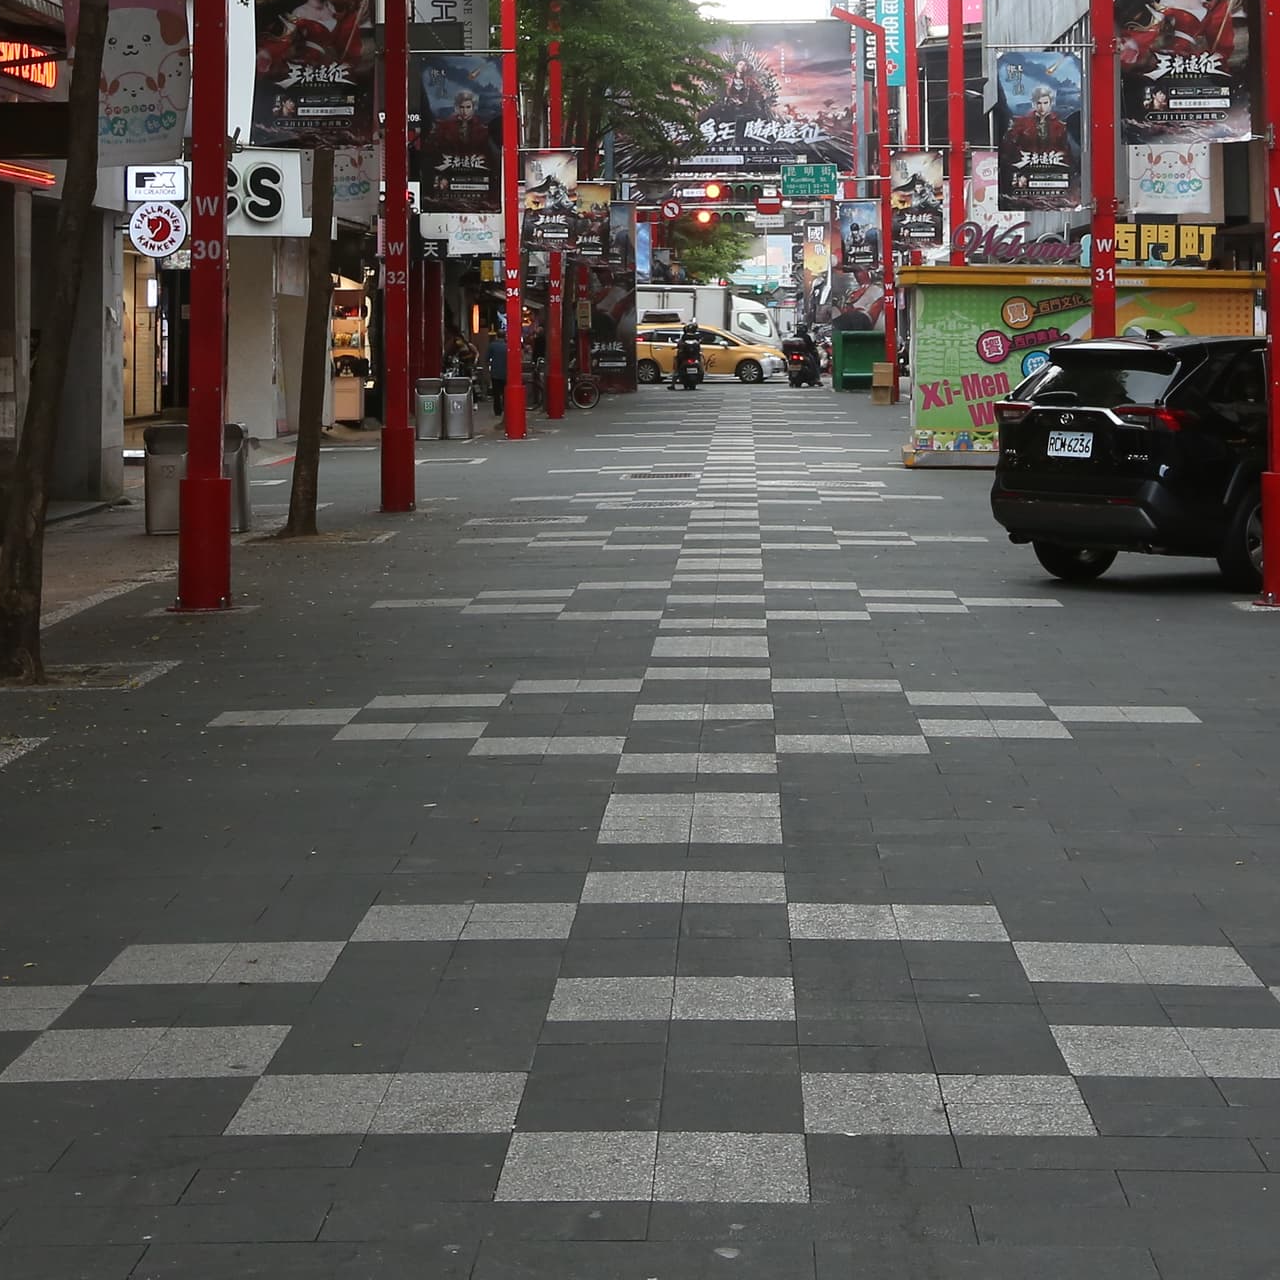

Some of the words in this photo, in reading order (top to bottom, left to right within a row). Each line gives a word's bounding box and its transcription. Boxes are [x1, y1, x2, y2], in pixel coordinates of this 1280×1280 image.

[1144, 51, 1233, 82] 王者遠征
[1012, 150, 1071, 169] 王者遠征
[135, 171, 176, 189] FX
[196, 196, 219, 216] W
[193, 239, 221, 260] 30
[388, 242, 404, 256] W
[952, 221, 1082, 261] Welcome
[1096, 239, 1113, 252] W
[1114, 223, 1217, 262] 西門町
[387, 271, 406, 284] 32
[506, 269, 518, 279] W
[1096, 268, 1113, 282] 31
[506, 288, 519, 297] 34
[551, 279, 560, 288] W
[919, 372, 1010, 411] Xi-Men
